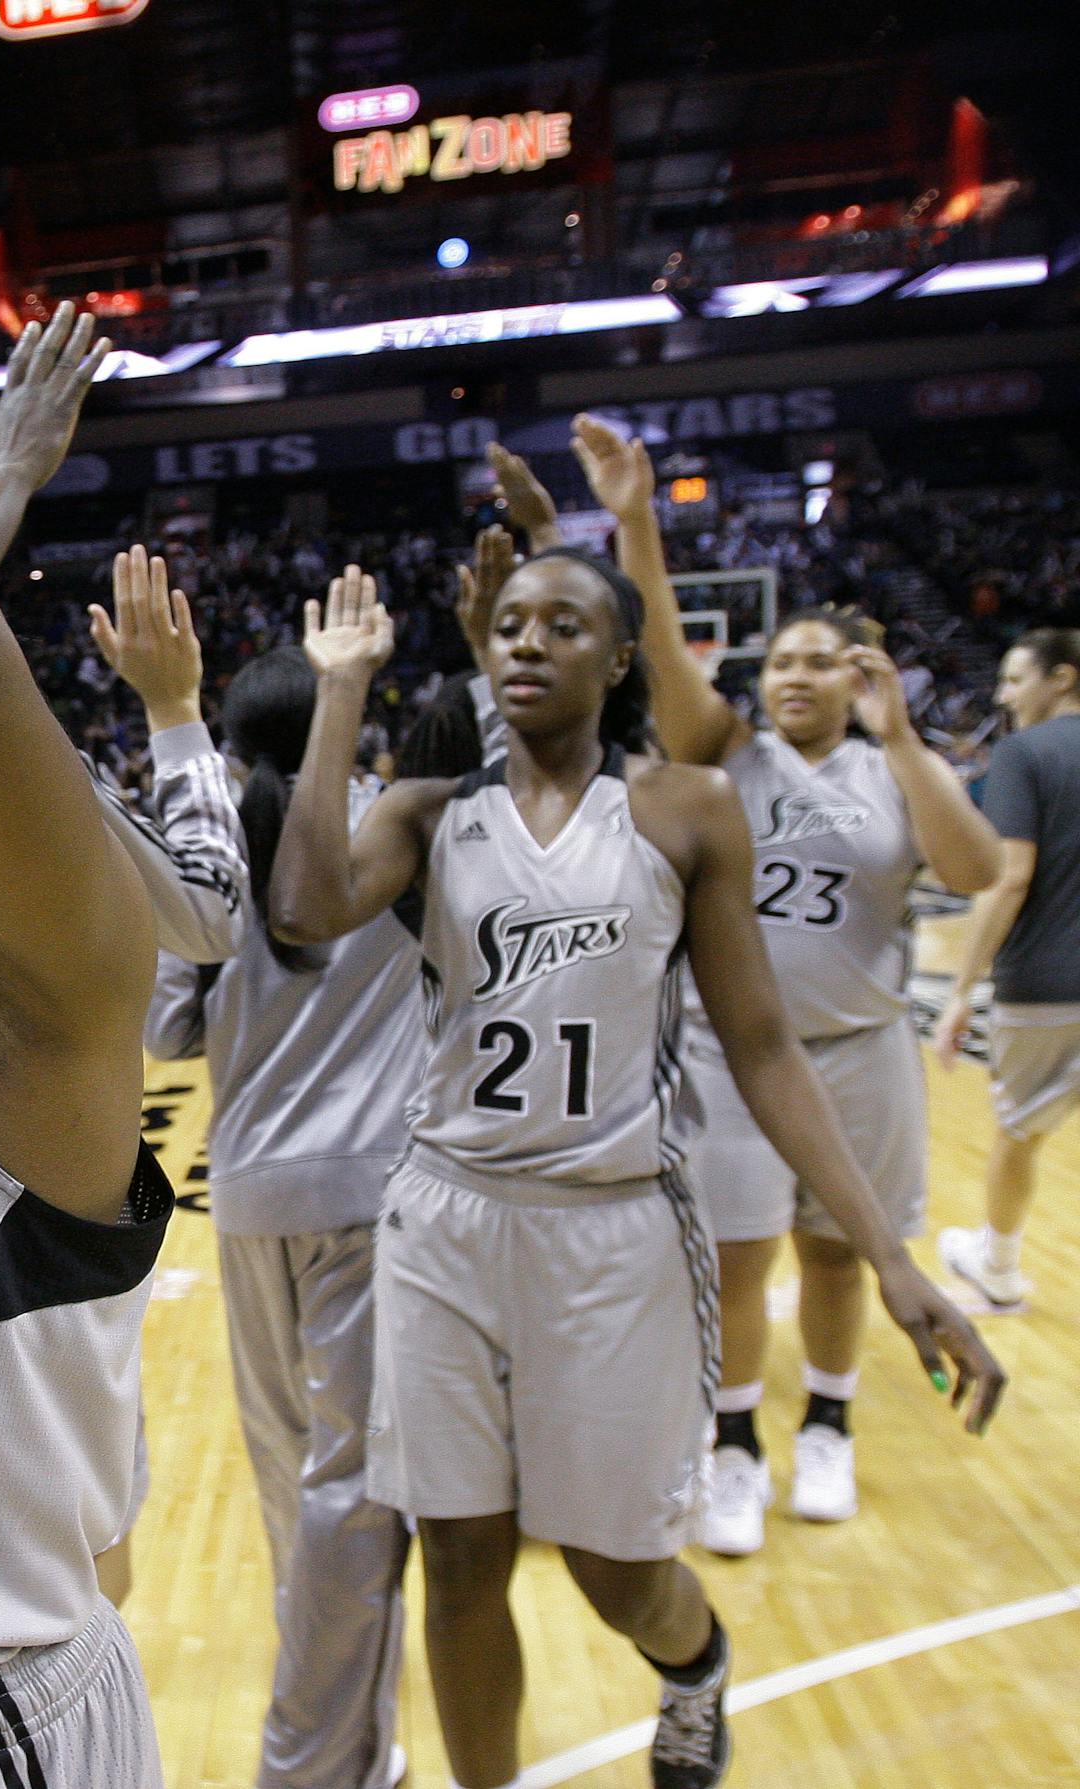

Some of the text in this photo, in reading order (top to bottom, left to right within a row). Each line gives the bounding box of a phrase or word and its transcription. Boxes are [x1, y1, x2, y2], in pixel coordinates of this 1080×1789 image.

[333, 111, 572, 193] FAN ZONE
[155, 434, 317, 482] LETS
[394, 416, 500, 463] GO
[753, 788, 870, 849] STARS
[753, 855, 856, 933] 23
[472, 895, 633, 1003] STARS
[470, 1015, 597, 1121] 21
